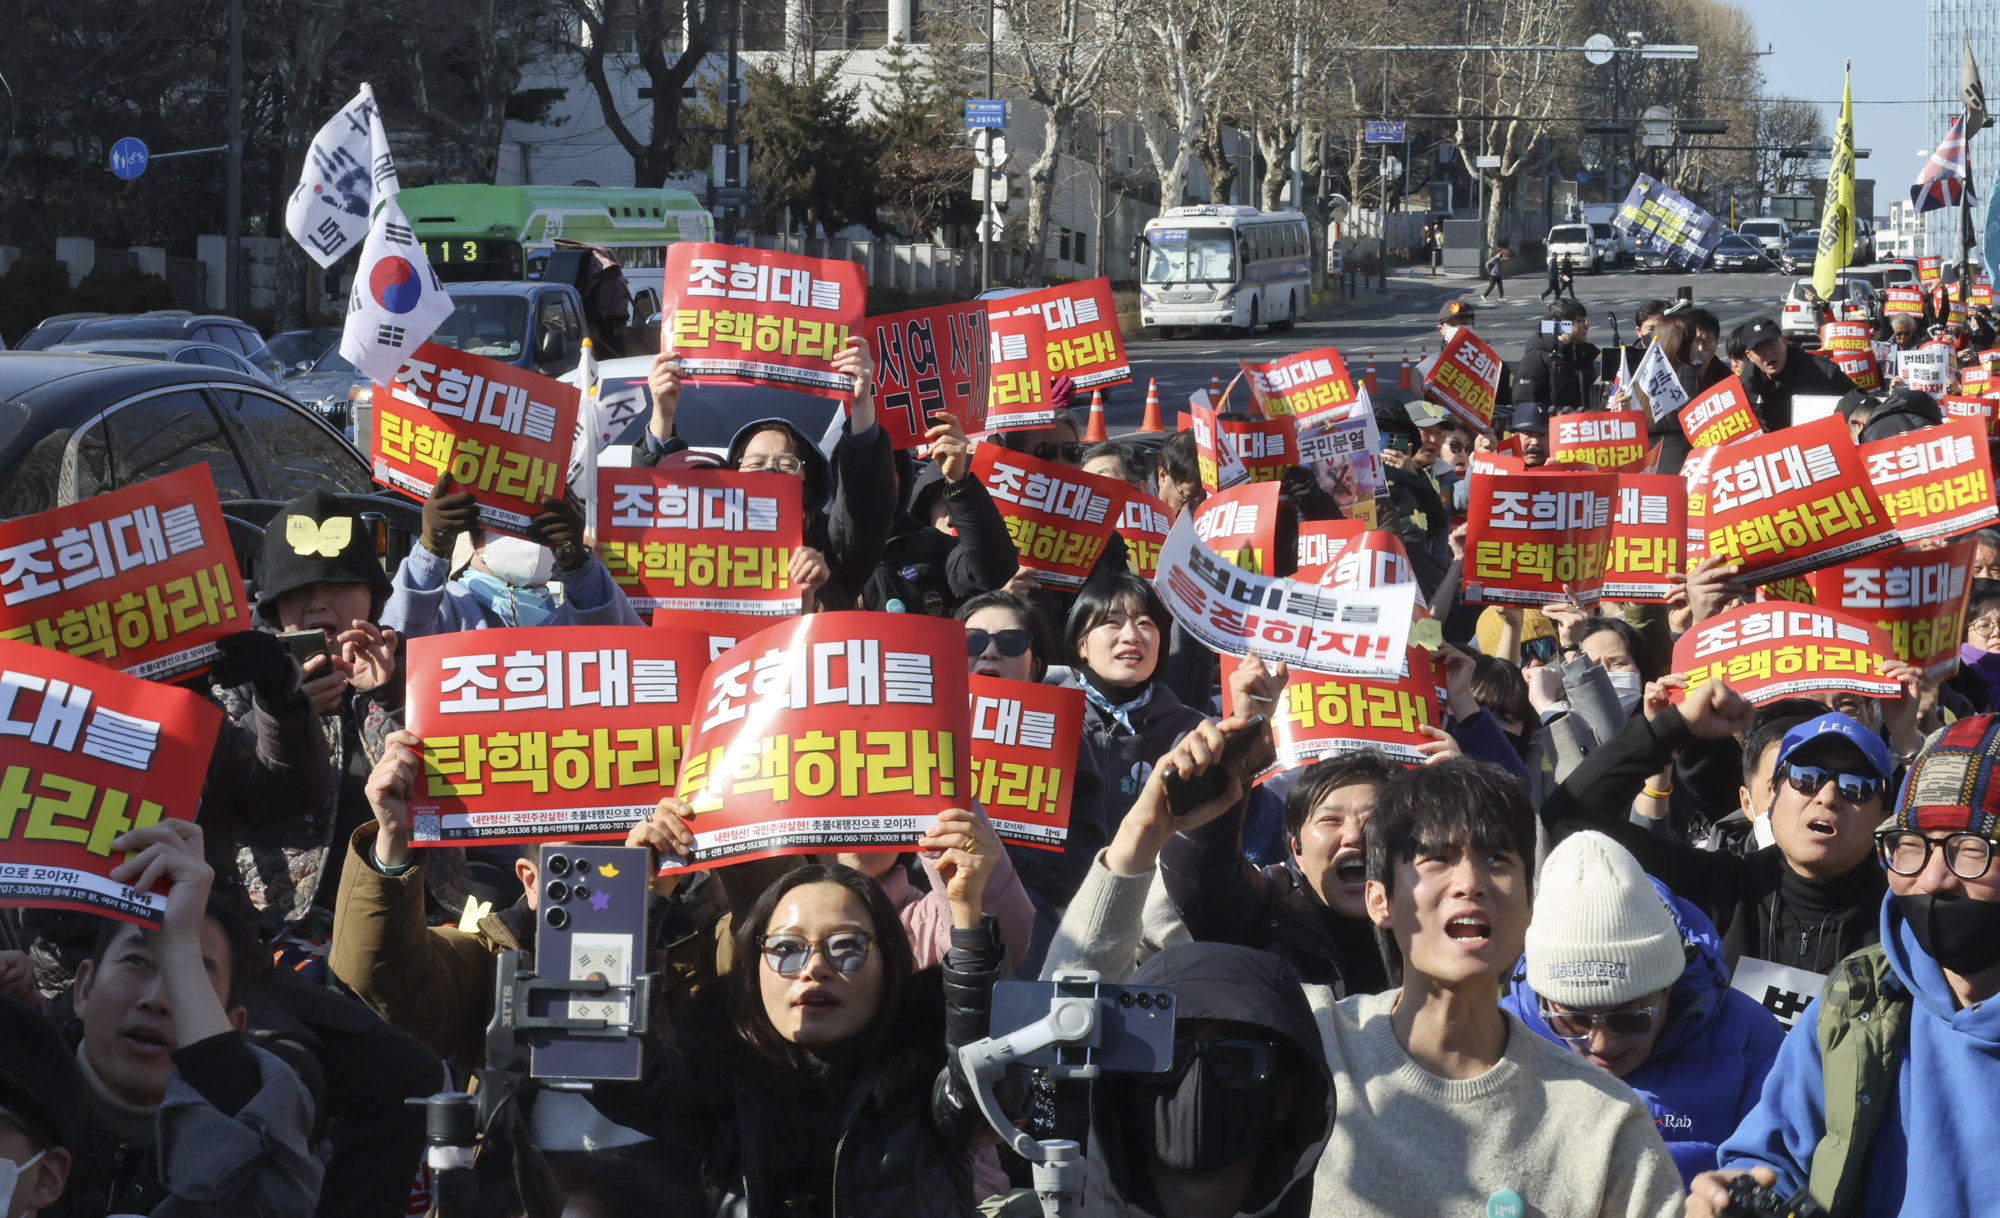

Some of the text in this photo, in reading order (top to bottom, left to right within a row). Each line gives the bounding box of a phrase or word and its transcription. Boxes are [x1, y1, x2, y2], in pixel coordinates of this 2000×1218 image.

[687, 259, 841, 311] 조희대를
[673, 309, 849, 361] 탄핵하라!
[989, 297, 1100, 331] 대를
[1046, 330, 1117, 372] 하라!
[871, 317, 945, 436] 석열
[391, 358, 557, 443] 조희대를
[1684, 390, 1737, 436] 조희대를
[1301, 429, 1365, 460] 국민분열
[1559, 418, 1637, 444] 조희대를
[380, 410, 558, 505] 탄핵하라!
[1867, 435, 1976, 486] 조희대를
[986, 461, 1111, 524] 조희대를
[1711, 444, 1841, 515] 조희대를
[498, 510, 520, 523] 모이자!
[612, 484, 778, 532] 조희대를
[1116, 501, 1171, 536] 대를
[1194, 500, 1259, 543] 희대를
[1489, 490, 1610, 531] 조희대를
[1708, 486, 1878, 569] 탄핵하라!
[0, 503, 205, 606] 조희대를
[599, 541, 790, 590] 탄핵하라!
[1476, 540, 1609, 583] 탄핵하라!
[1841, 563, 1967, 609] 조희대를
[1167, 563, 1391, 661] 응징하자!
[190, 643, 215, 657] 모이자!
[1694, 610, 1871, 659] 조희대를
[439, 649, 678, 714] 조희대를
[701, 639, 934, 734] 조희대를
[969, 693, 1056, 749] 대를
[1817, 719, 1853, 735] LEE
[1383, 743, 1406, 754] 모이자!
[677, 729, 956, 816] 탄핵하라!
[449, 829, 462, 838] 후원
[467, 828, 480, 837] 신한
[480, 826, 530, 836] 100-036-551308
[585, 823, 598, 831] ARS
[472, 814, 511, 825] 내란청산!
[513, 811, 568, 824] 국민주권실현!
[571, 808, 631, 820] 촛불대행진으로
[714, 818, 916, 843] 내란청산! 국민주권실현! 촛불대행진으로 모이자!
[1003, 822, 1026, 831] 모이자!
[695, 850, 707, 860] 후원
[711, 848, 723, 857] 신한
[723, 839, 769, 855] 100-036-551308
[829, 834, 843, 842] ARS
[844, 833, 900, 842] 060-707-3300(한
[0, 866, 80, 884] 으로 모이자!
[53, 887, 70, 897] 통에
[72, 890, 87, 899] 1만
[88, 892, 99, 903] 원,
[101, 897, 118, 907] 여러
[120, 901, 129, 911] 번
[130, 906, 151, 918] 가능)
[1546, 959, 1628, 982] DISCOVERY
[502, 984, 512, 1028] SLIK
[1664, 1113, 1692, 1130] Rab
